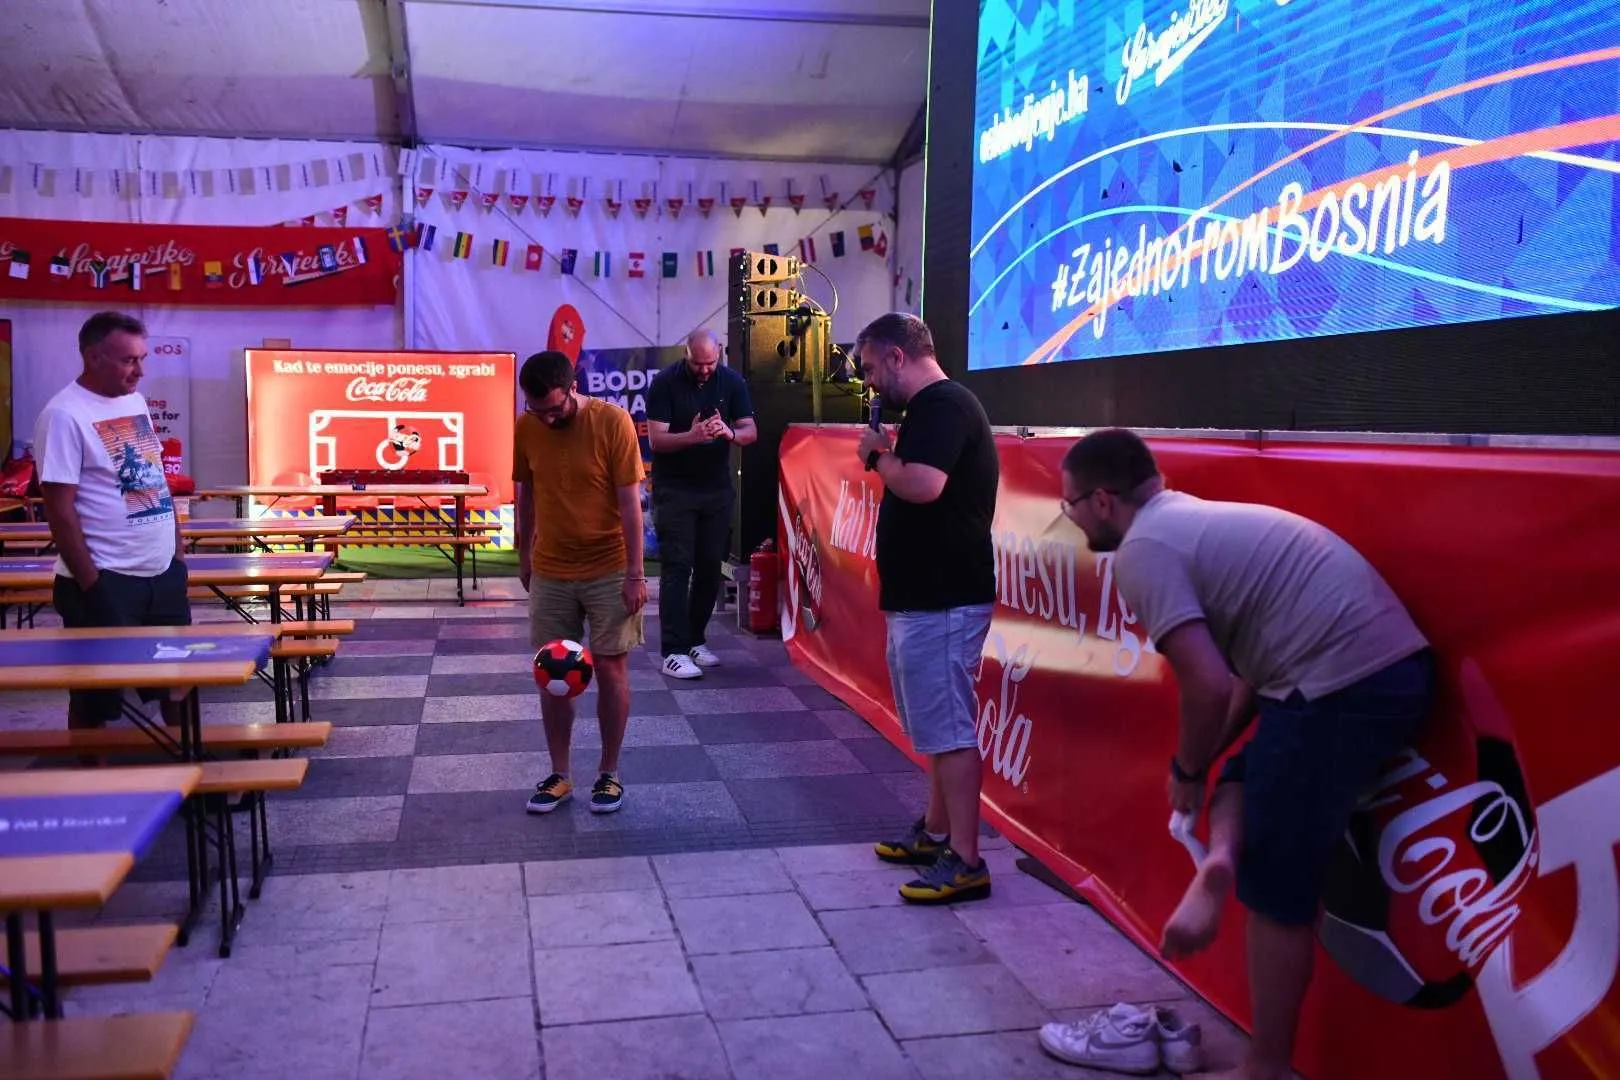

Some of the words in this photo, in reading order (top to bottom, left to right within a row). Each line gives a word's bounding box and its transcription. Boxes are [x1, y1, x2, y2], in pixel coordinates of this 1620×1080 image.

[1051, 150, 1451, 339] #ZajednoFromBosnia
[273, 360, 303, 374] Kad
[306, 361, 322, 374] te
[324, 361, 384, 377] emocije
[387, 363, 445, 377] ponesu,
[448, 363, 495, 378] zgrabi
